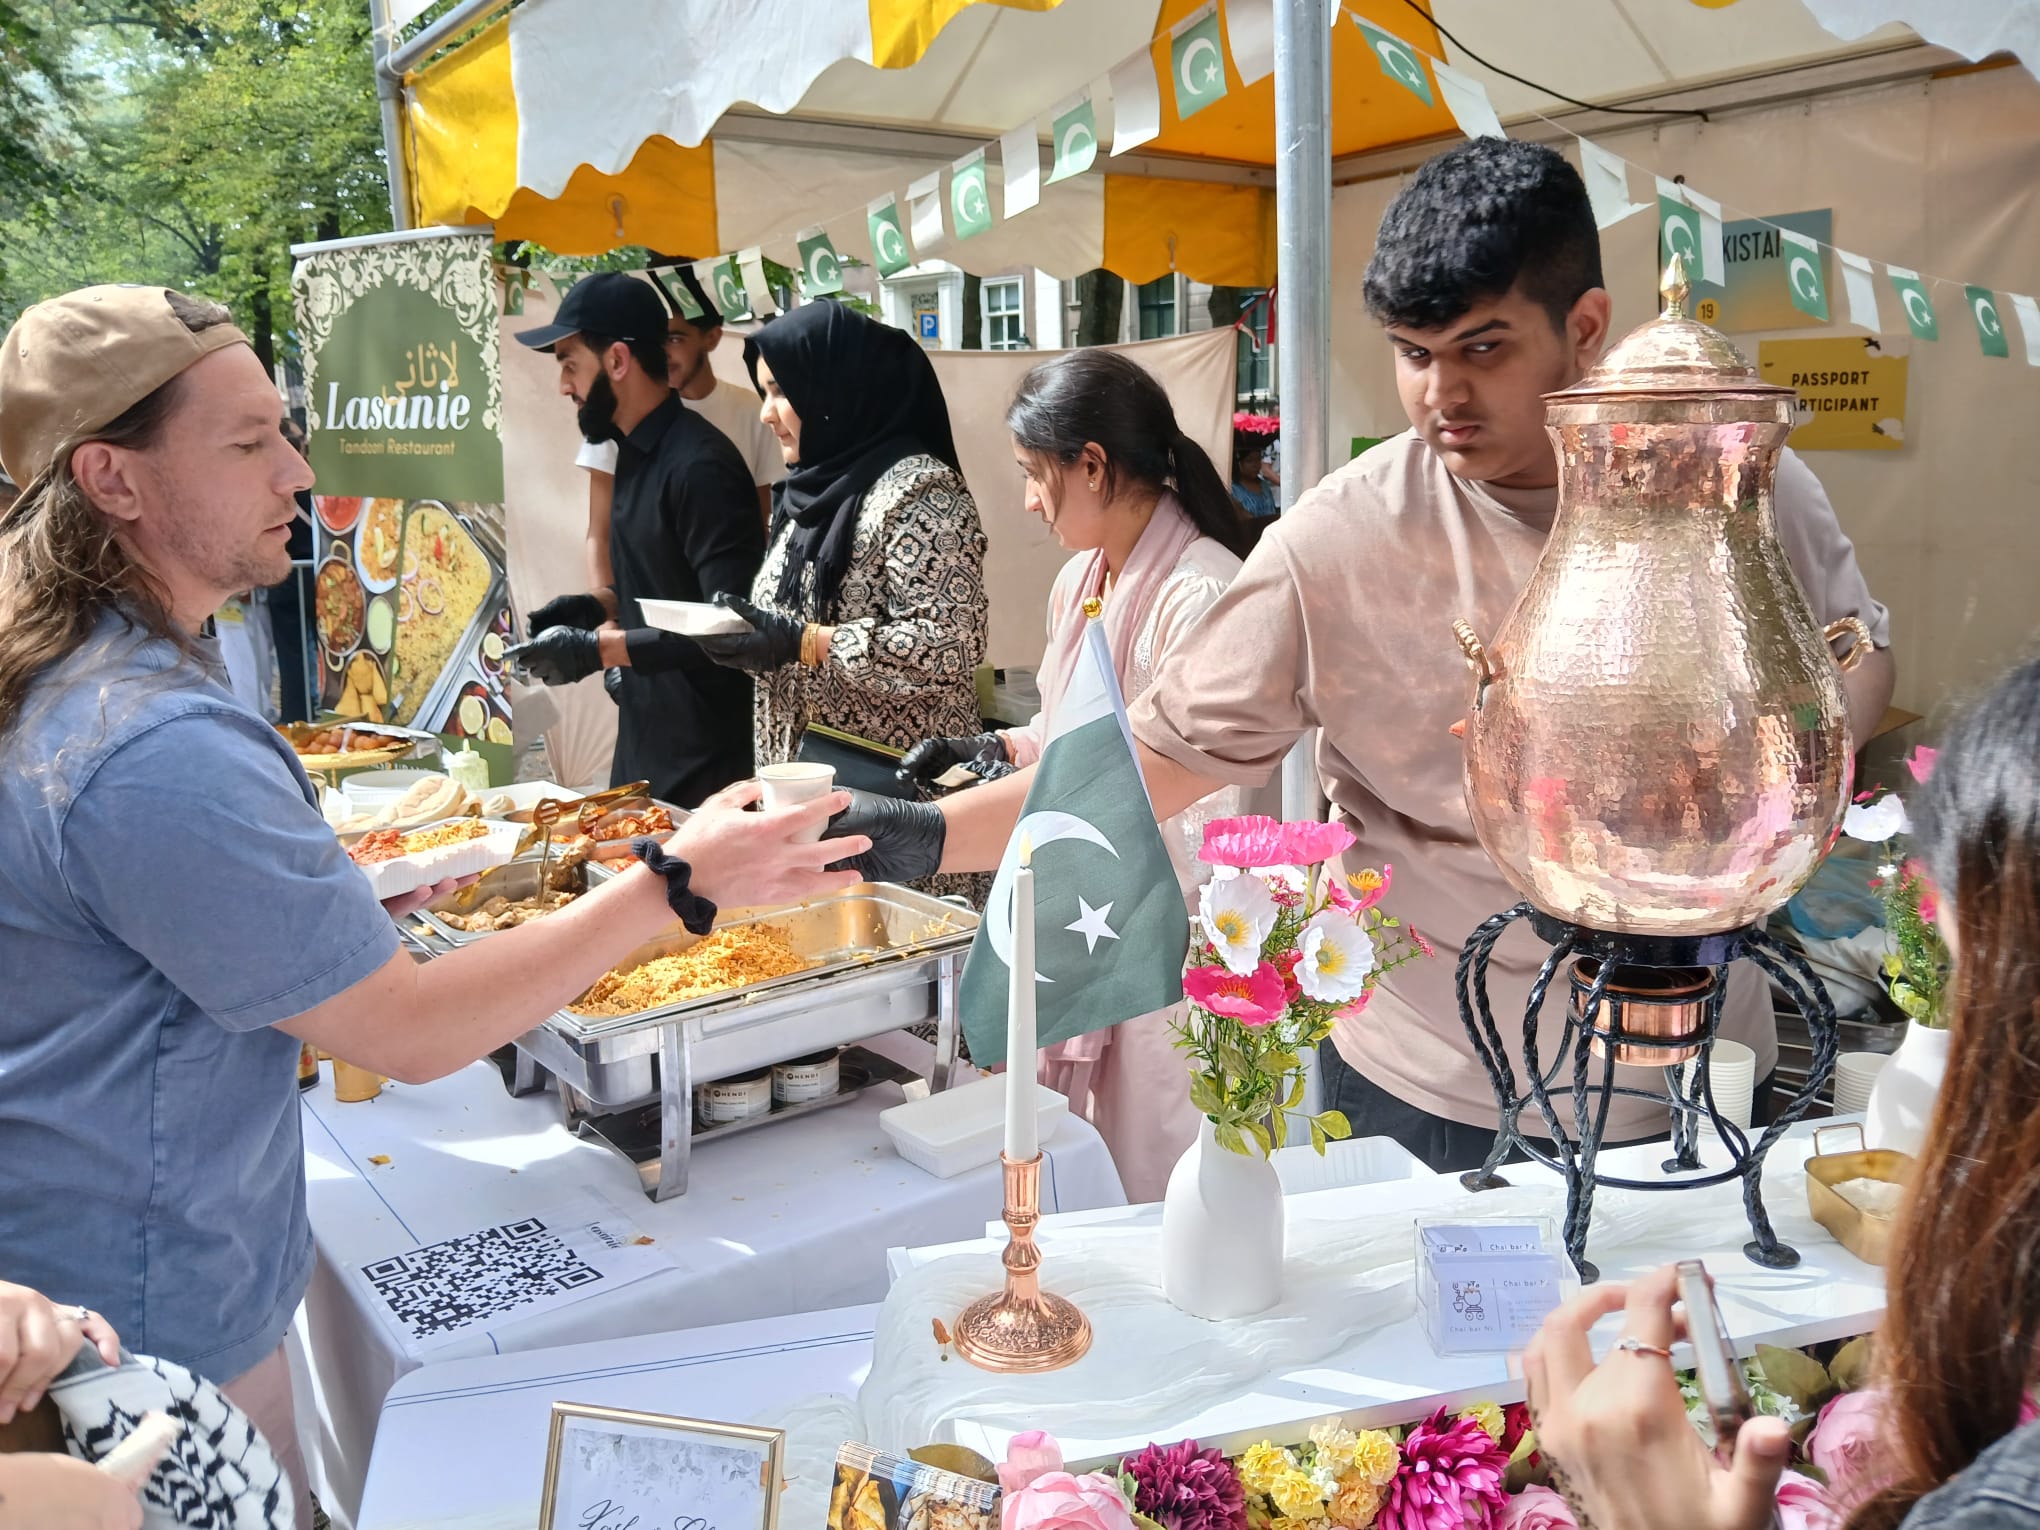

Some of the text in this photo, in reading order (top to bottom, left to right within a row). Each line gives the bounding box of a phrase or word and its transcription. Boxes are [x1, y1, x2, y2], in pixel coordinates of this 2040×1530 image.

[1722, 229, 1781, 263] KISTA
[1700, 304, 1714, 320] 19
[922, 316, 935, 336] P
[1791, 371, 1870, 387] PASSPORT
[325, 379, 471, 430] Lasanie
[1793, 397, 1879, 412] RTICIPANT
[386, 438, 456, 456] Restaurant
